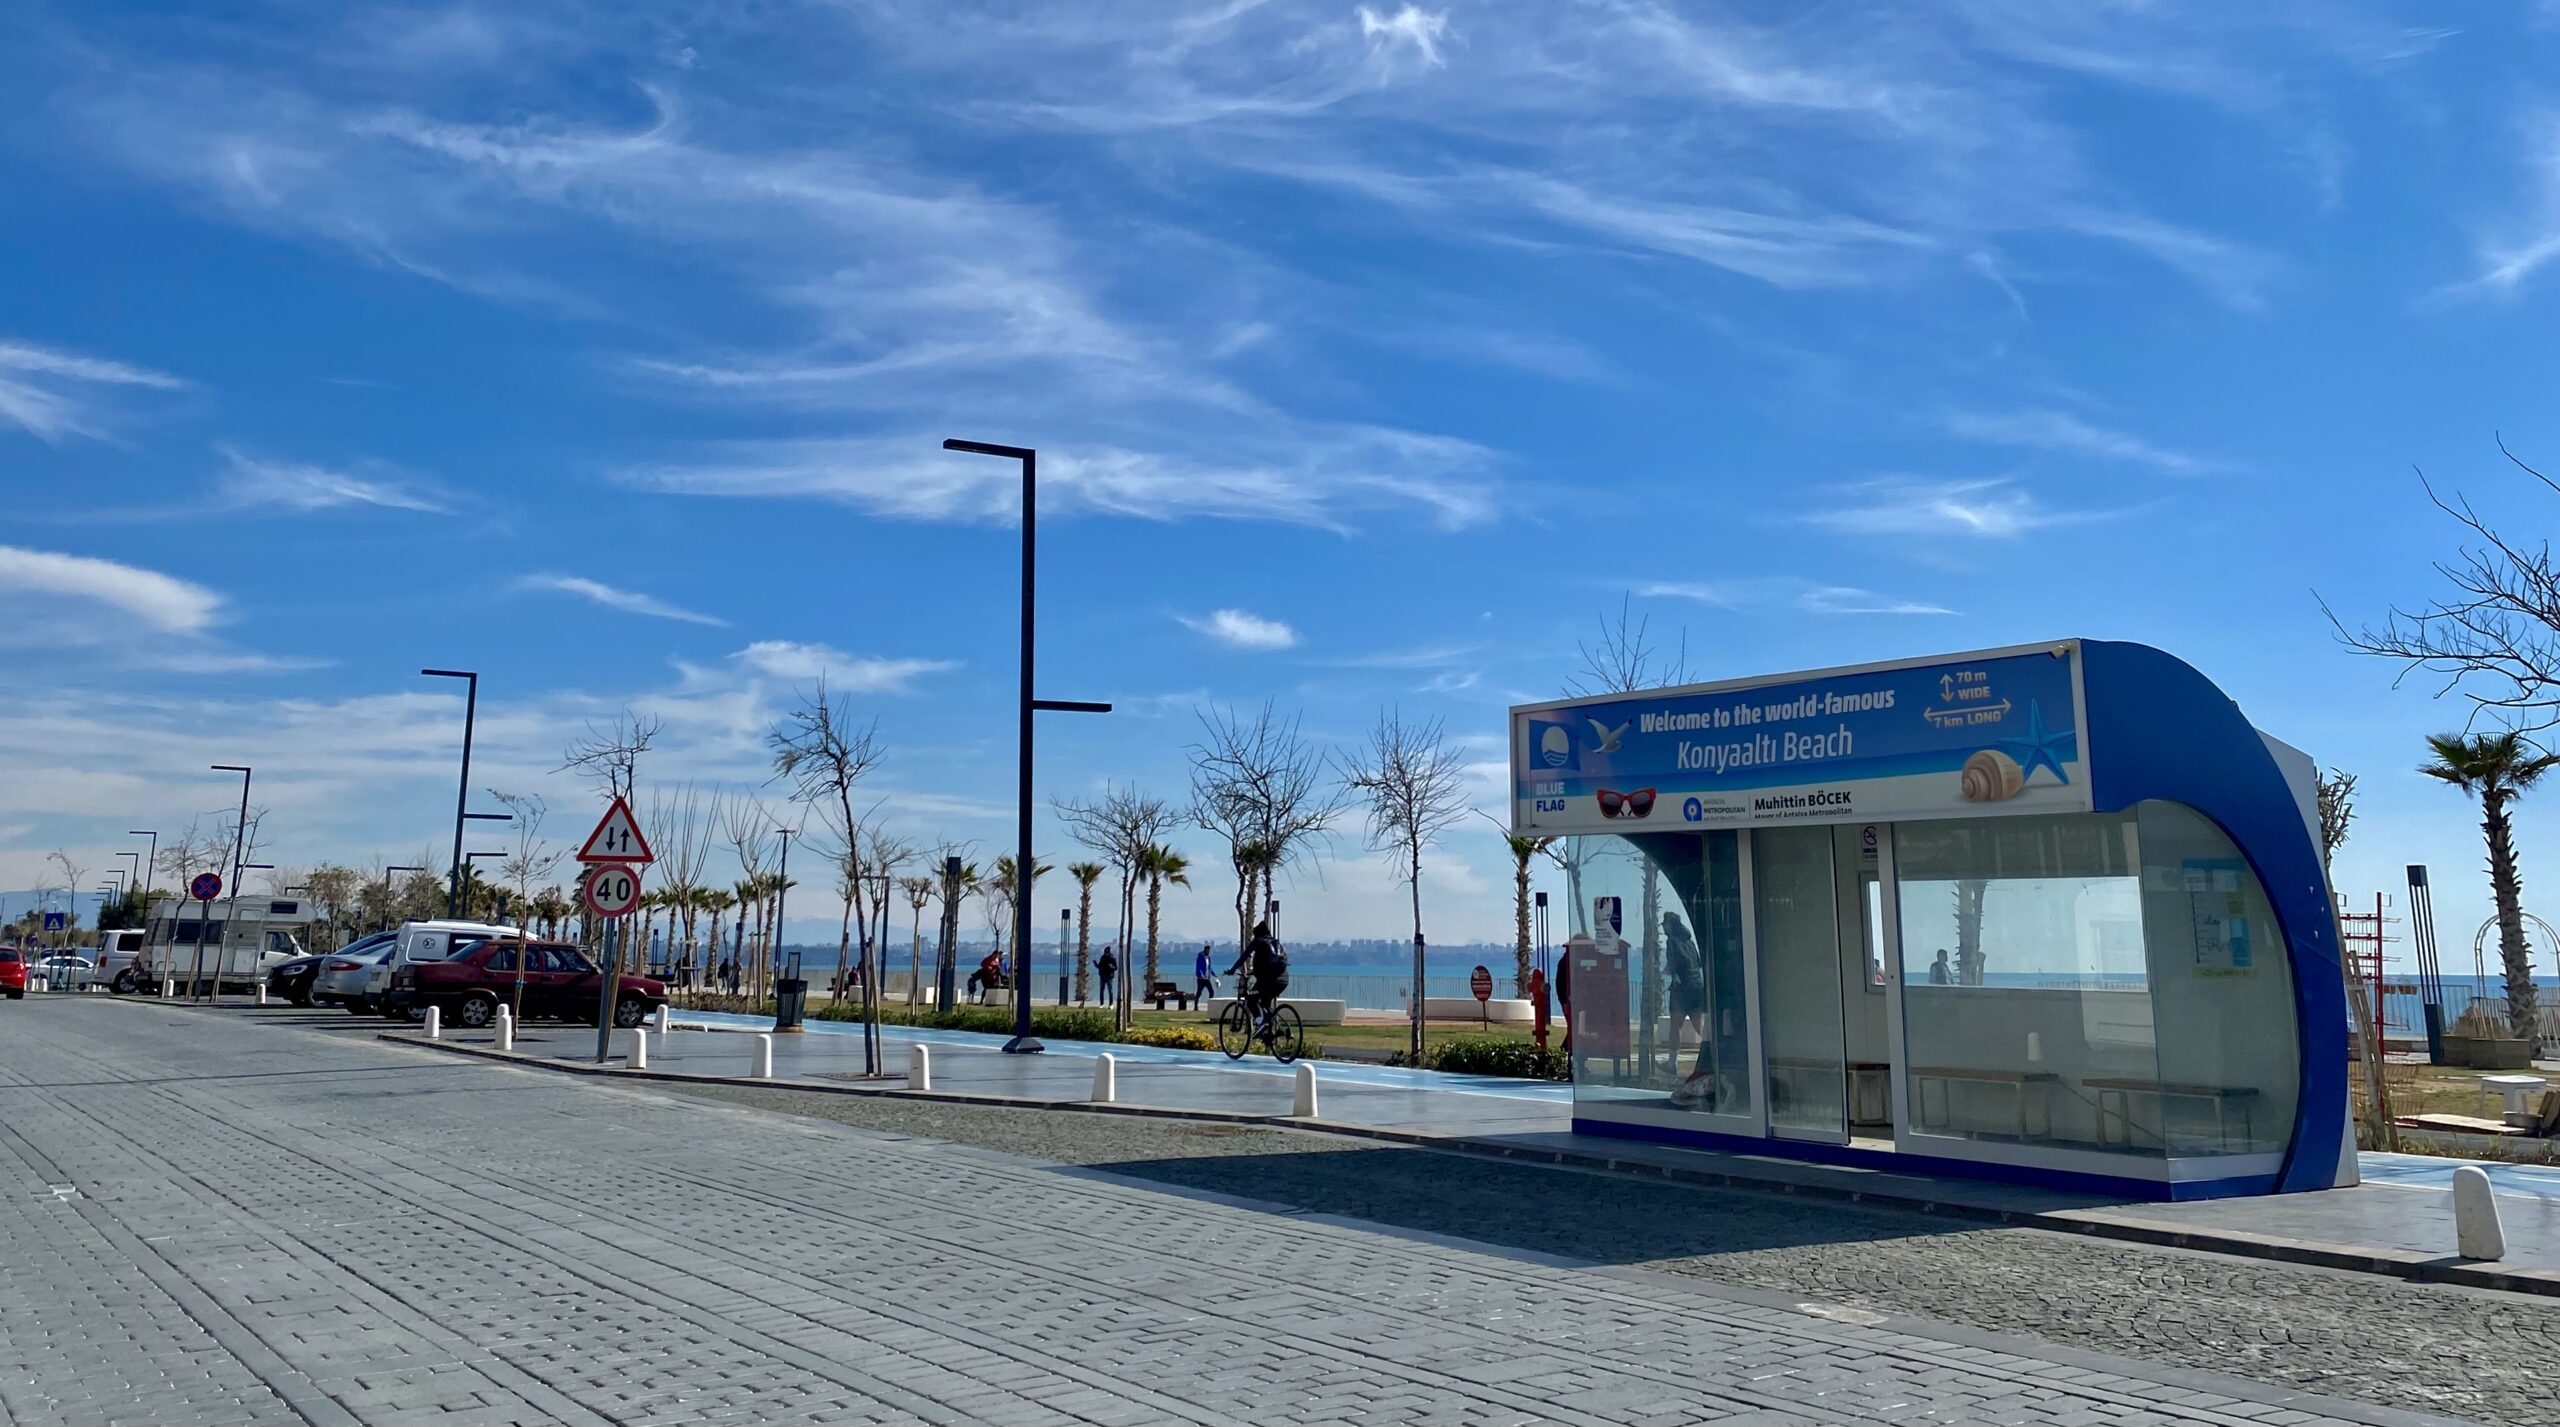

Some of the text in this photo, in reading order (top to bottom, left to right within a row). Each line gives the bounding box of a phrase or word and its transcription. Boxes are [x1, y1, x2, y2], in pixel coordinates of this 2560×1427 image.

[1956, 671, 1987, 683] 70 m
[1957, 686, 1991, 701] WIDE
[1640, 689, 1895, 733] Welcome to the world-famous
[1934, 711, 2002, 728] 7 km LONG
[1677, 724, 1853, 775] Konyaaltı Beach
[1536, 782, 1565, 795] BLUE
[1536, 799, 1565, 813] FLAG
[1754, 790, 1852, 811] Muhittin BÖCEK
[1703, 806, 1746, 814] METROPOLITAN
[596, 877, 631, 902] 40
